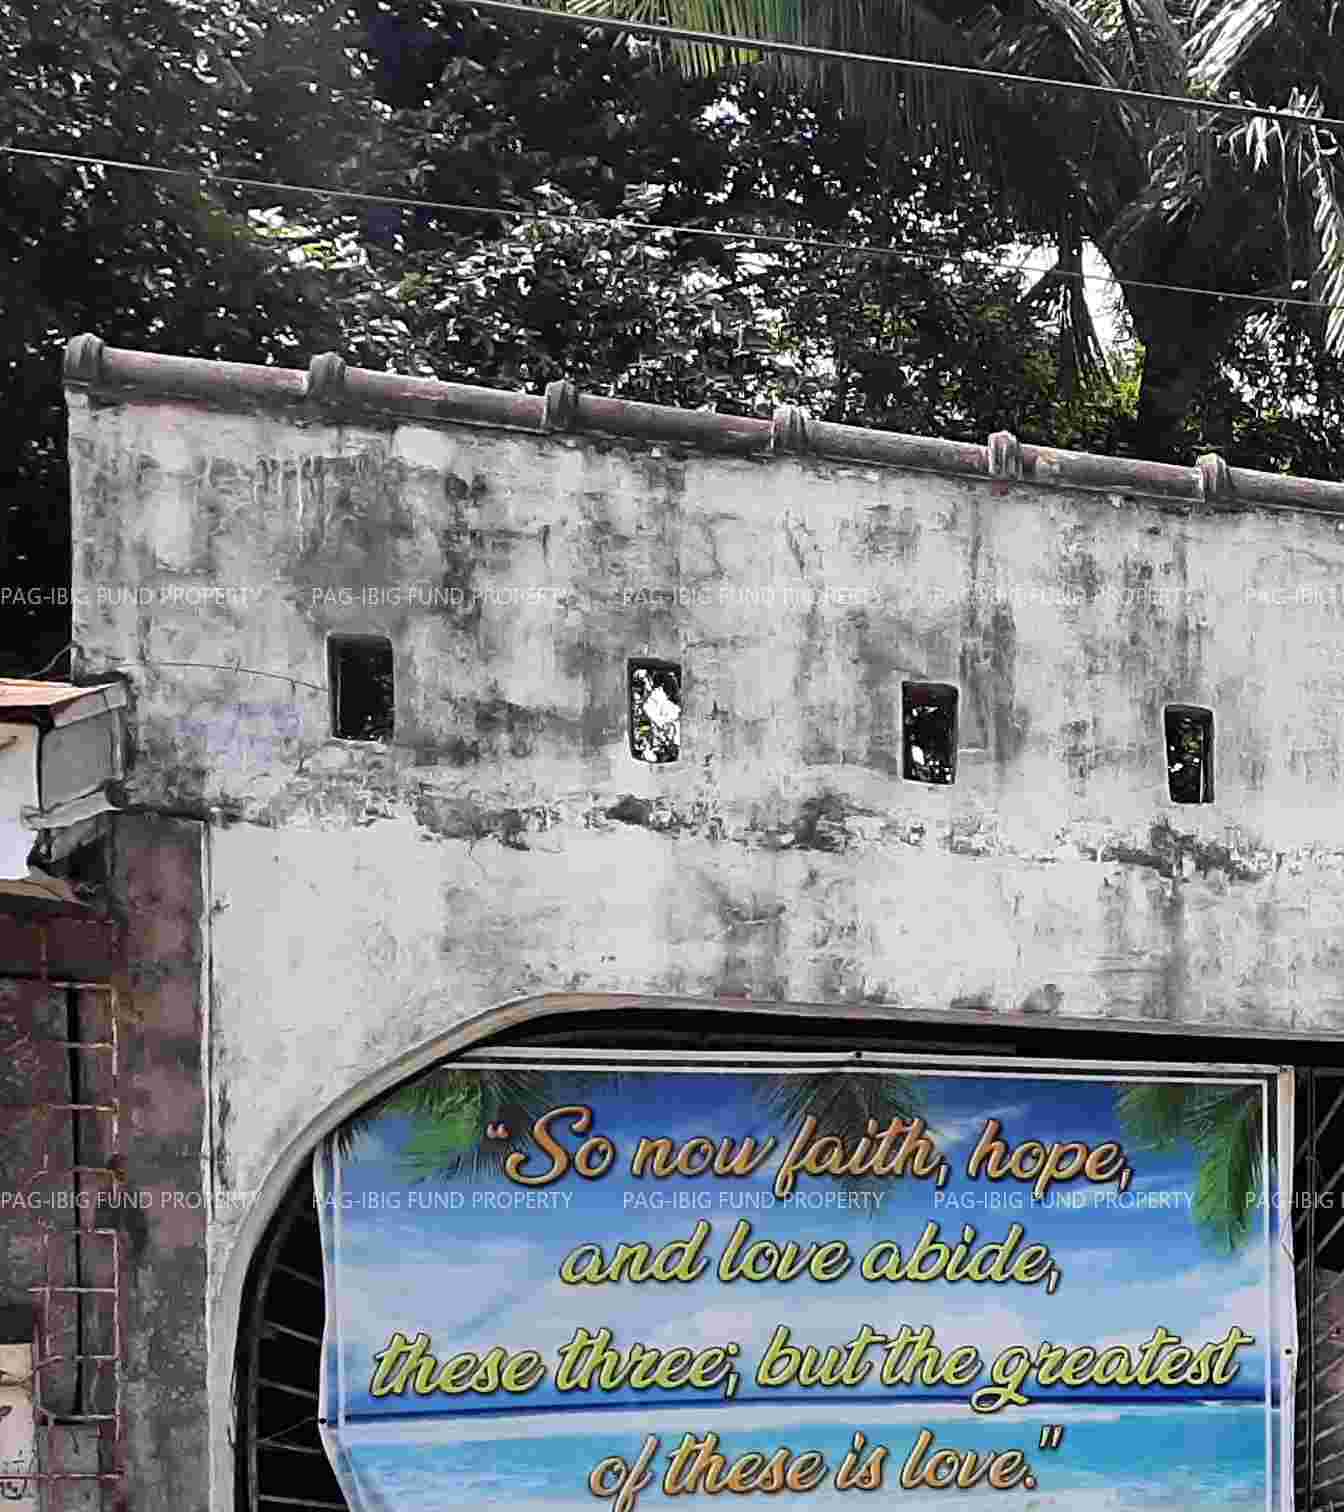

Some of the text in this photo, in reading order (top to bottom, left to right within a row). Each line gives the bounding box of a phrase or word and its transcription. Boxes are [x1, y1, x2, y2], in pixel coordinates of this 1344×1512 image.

[630, 1133, 776, 1177] now
[775, 1116, 950, 1198] faith,
[969, 1118, 1134, 1199] hope,
[559, 1219, 1061, 1294] and love abide,
[369, 1331, 546, 1397] these
[757, 1325, 886, 1387] but
[877, 1325, 981, 1387] the
[970, 1326, 1254, 1412] greatest
[663, 1431, 827, 1496] these
[836, 1430, 889, 1489] is
